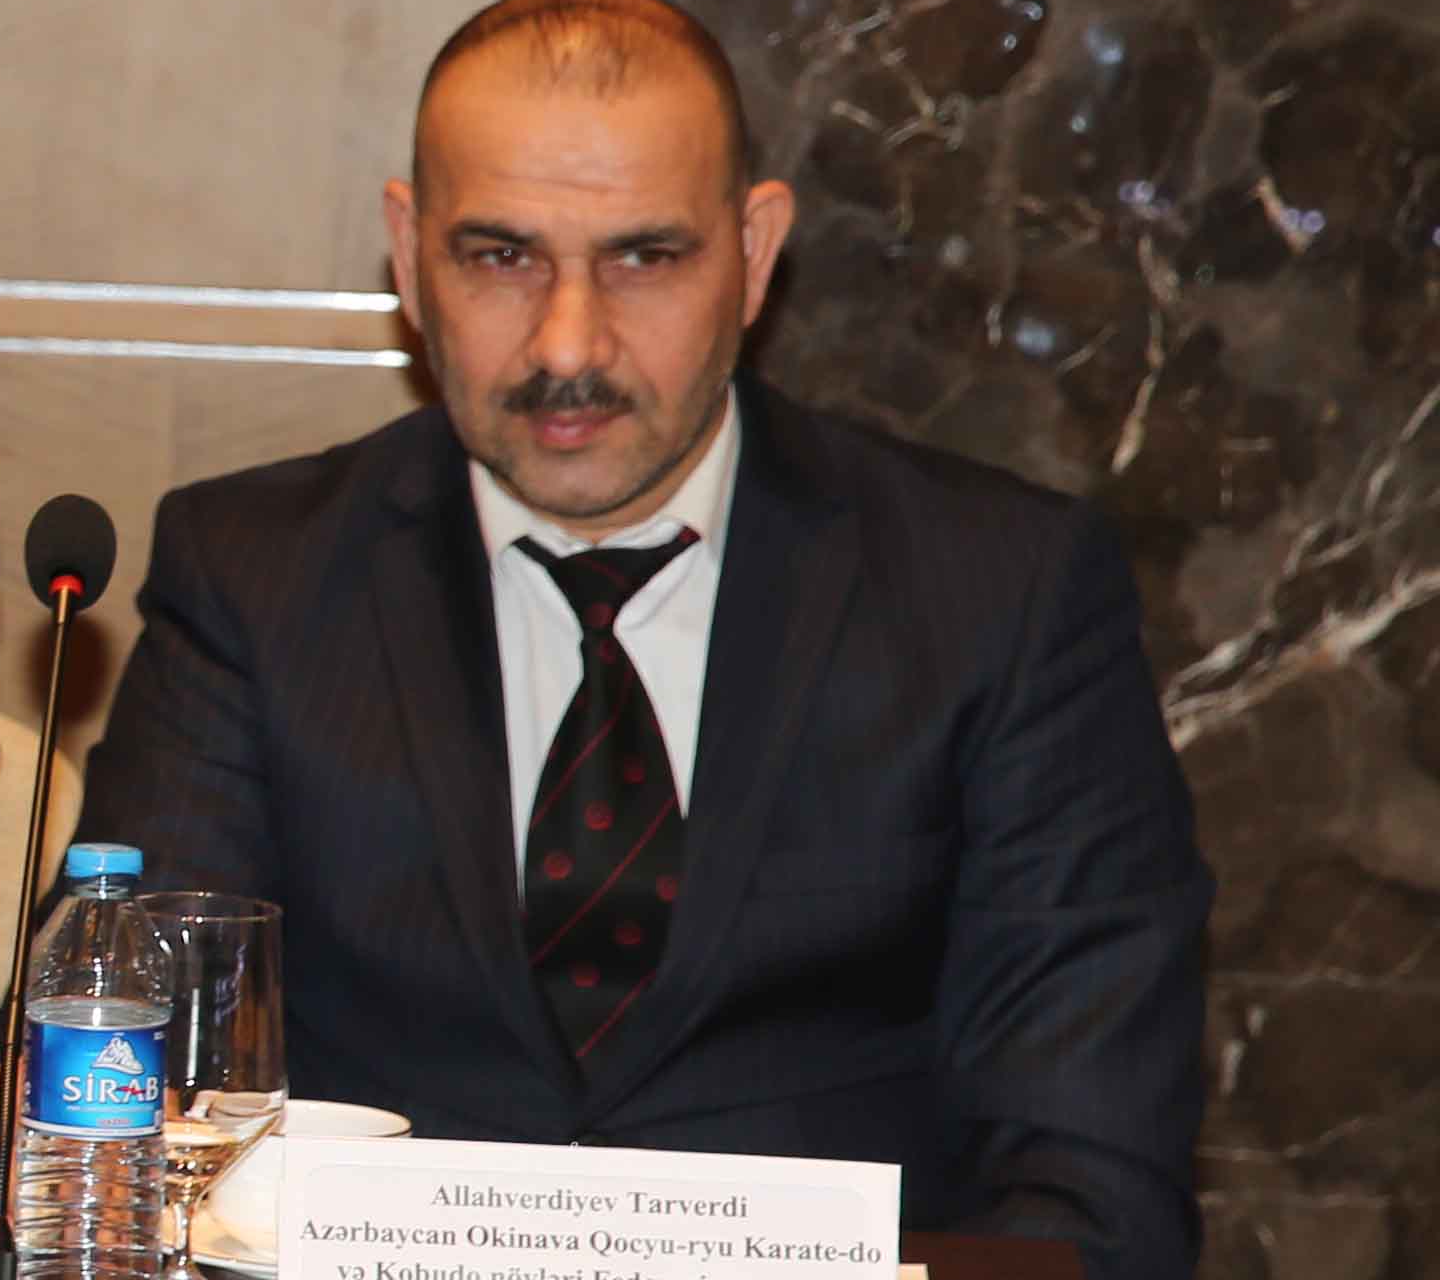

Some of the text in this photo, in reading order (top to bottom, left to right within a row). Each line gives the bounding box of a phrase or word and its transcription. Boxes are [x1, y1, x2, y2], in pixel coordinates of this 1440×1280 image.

[432, 1184, 748, 1218] Allahverdiyev Tarverdi
[300, 1219, 881, 1263] Azərbaycan Okinava Qocyu-ryu Karate-do
